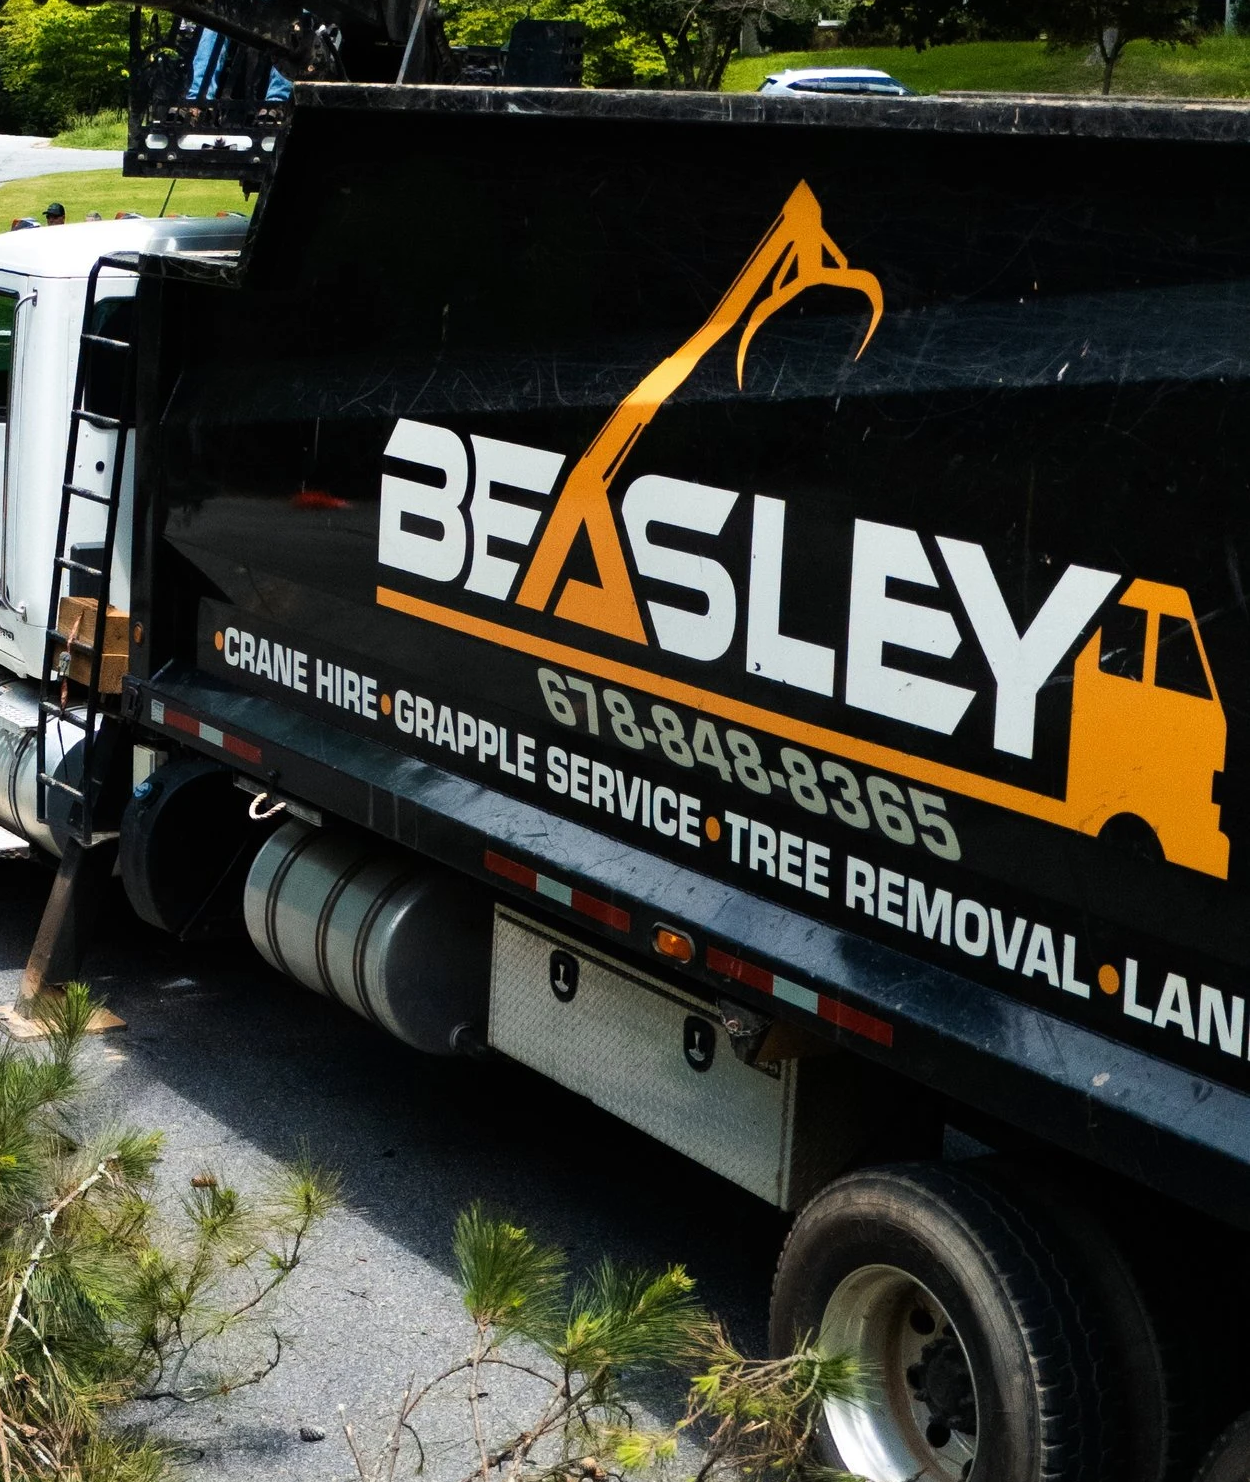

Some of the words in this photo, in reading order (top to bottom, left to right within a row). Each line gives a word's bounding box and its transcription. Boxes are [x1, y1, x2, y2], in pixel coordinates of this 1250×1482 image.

[377, 417, 1122, 760] BEASLEY
[224, 626, 308, 694] CRANE
[316, 658, 377, 720] HIRE
[394, 689, 536, 784] GRAPPLE
[546, 745, 701, 847] SERVICE
[724, 810, 831, 898] TREE
[846, 855, 1090, 999] REMOVAL
[1123, 957, 1250, 1062] LAN
[537, 667, 961, 861] 678-848-8365
